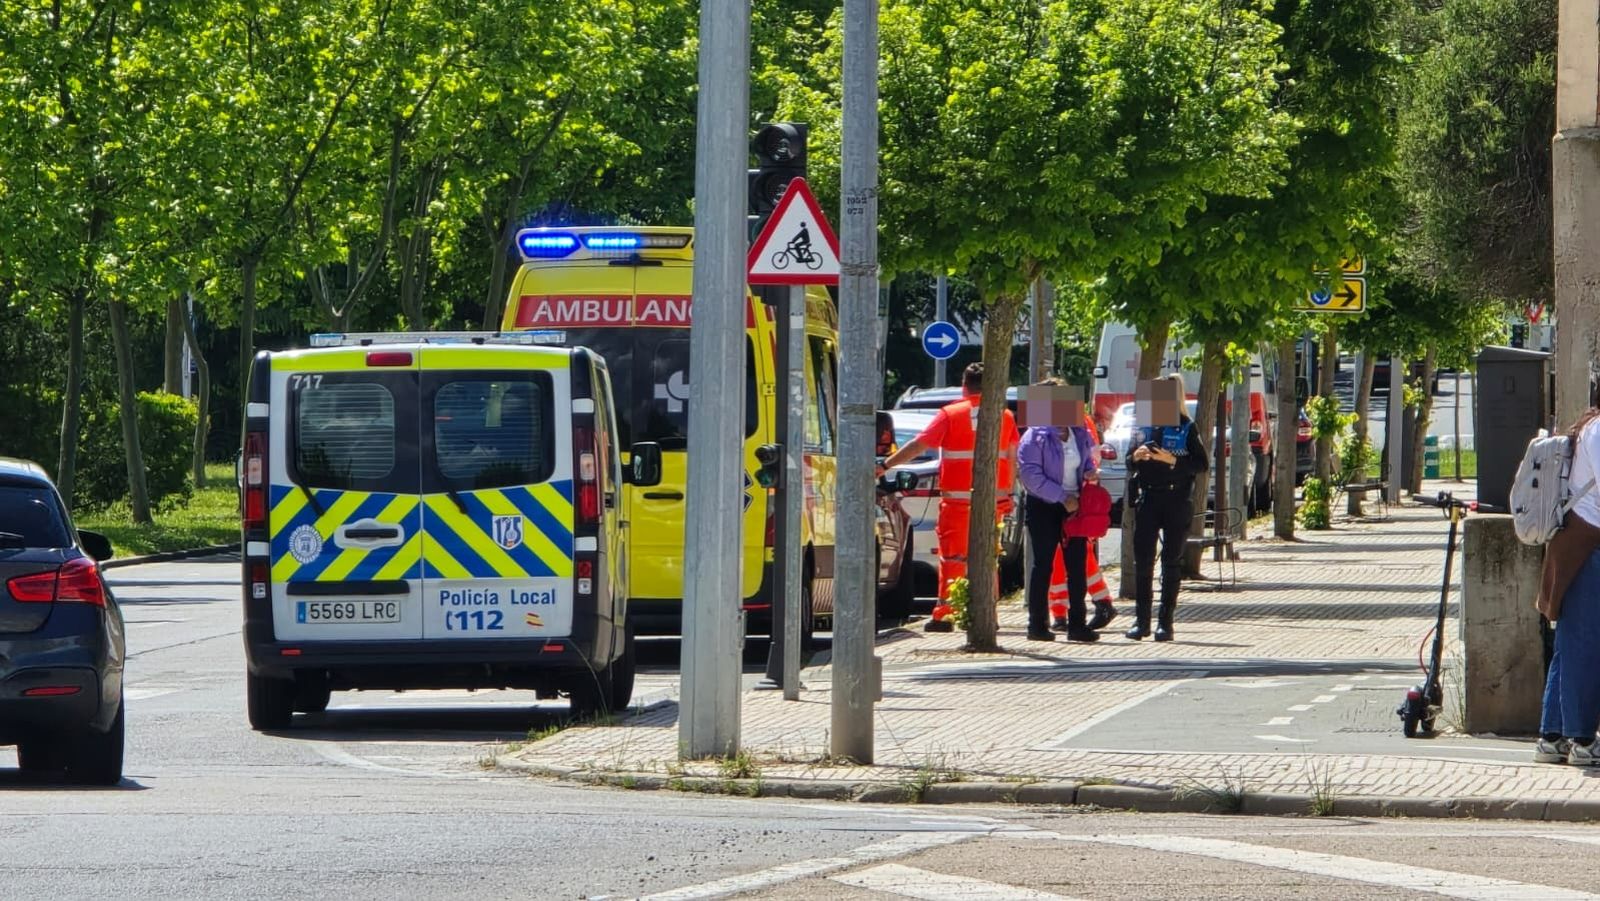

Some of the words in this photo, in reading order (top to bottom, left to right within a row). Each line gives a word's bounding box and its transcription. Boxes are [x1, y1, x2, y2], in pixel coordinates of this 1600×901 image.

[532, 299, 692, 322] AMBULAN
[292, 374, 324, 390] 717
[440, 588, 499, 606] Policía
[510, 588, 556, 605] Local
[310, 603, 356, 619] 5569
[362, 602, 396, 619] LRC
[454, 609, 504, 631] 112
